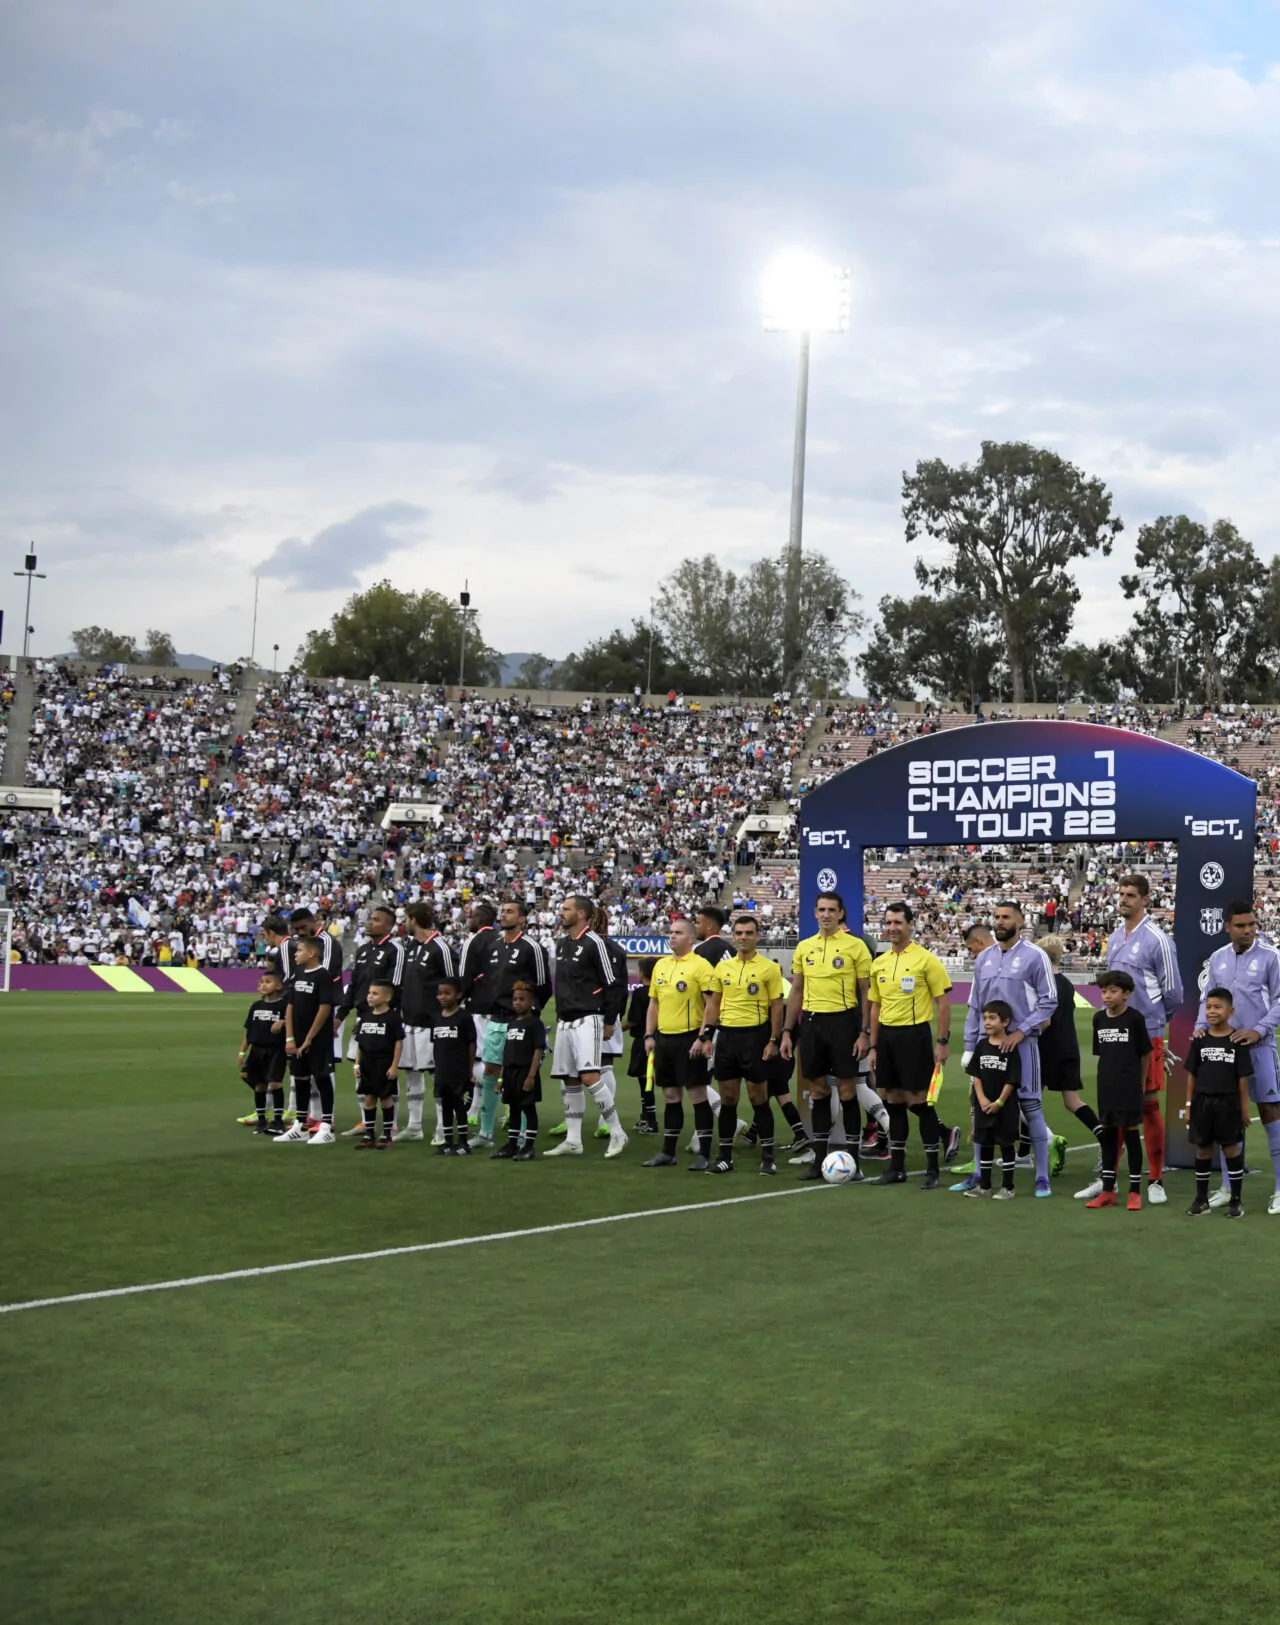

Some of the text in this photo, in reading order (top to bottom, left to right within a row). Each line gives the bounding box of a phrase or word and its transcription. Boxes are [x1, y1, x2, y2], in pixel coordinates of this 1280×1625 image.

[909, 756, 1056, 784] SOCCER
[909, 781, 1116, 812] CHAMPIONS
[809, 830, 846, 846] SCT
[956, 810, 1116, 838] TOUR 22
[1192, 818, 1238, 836] SCT
